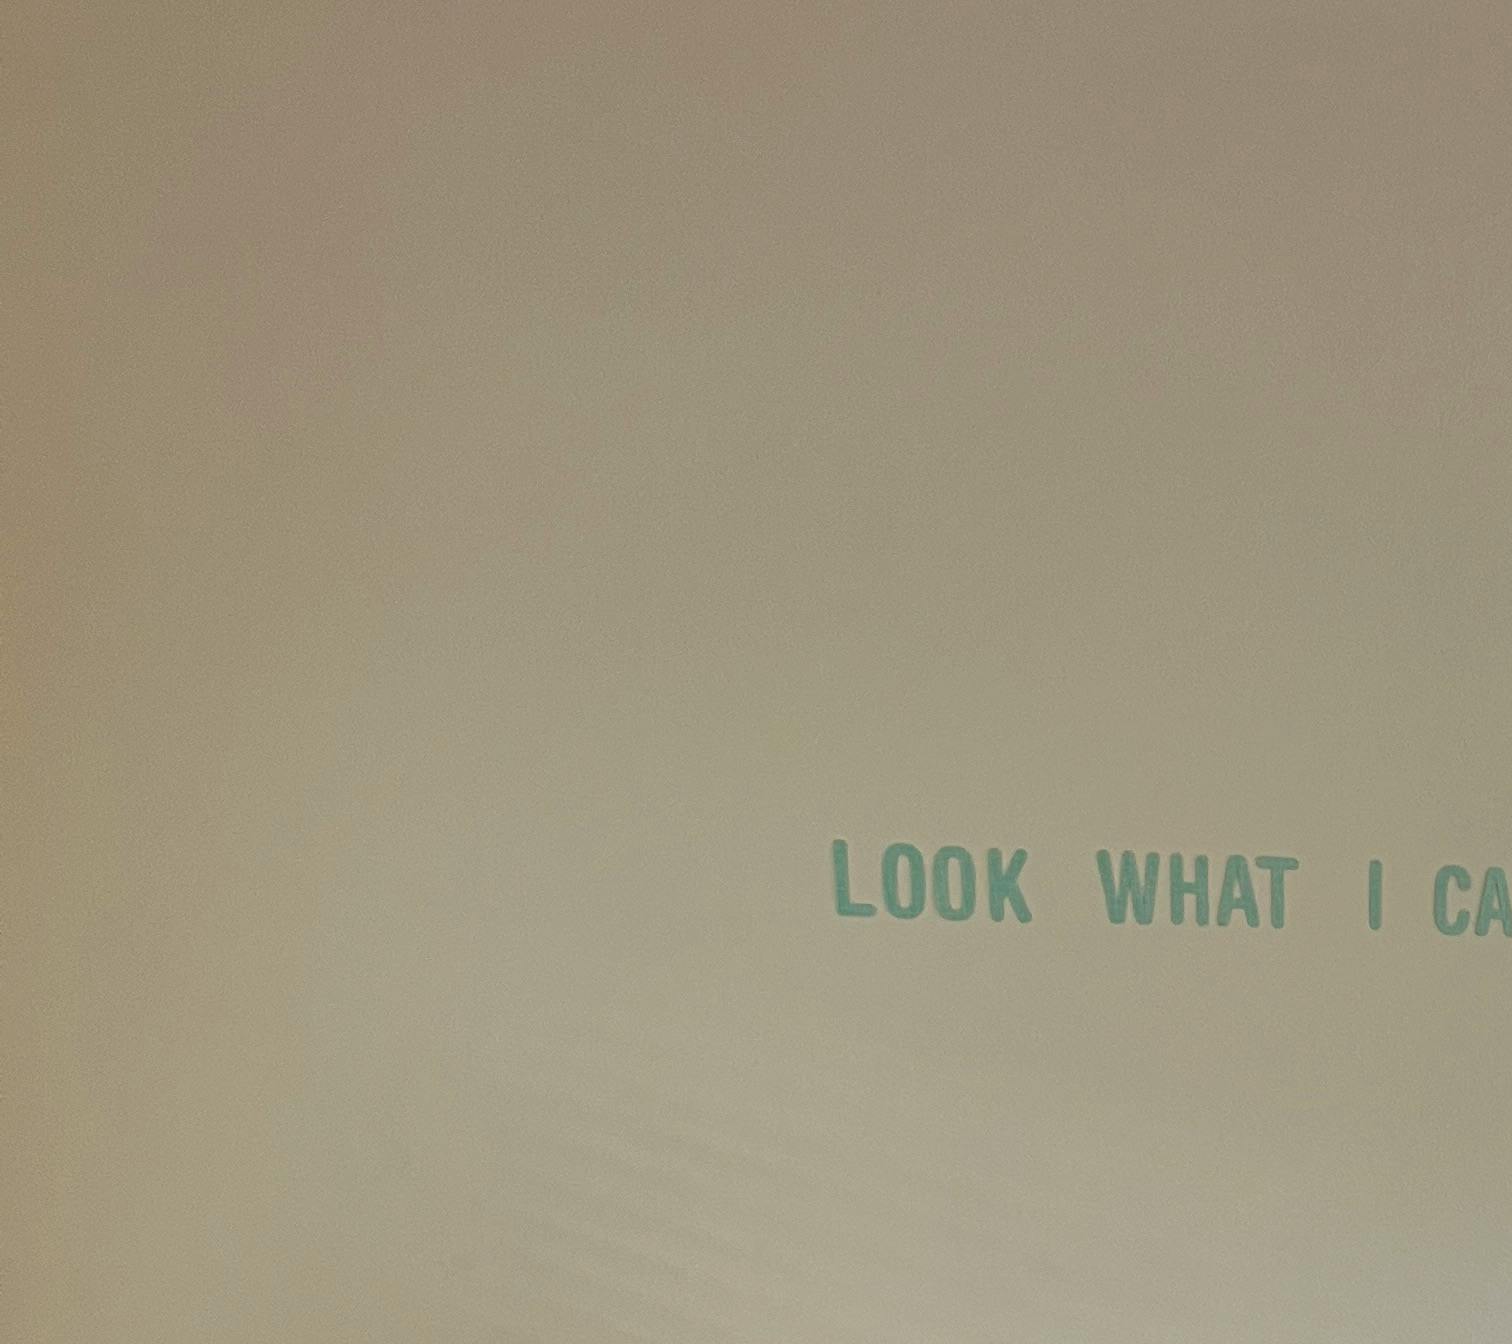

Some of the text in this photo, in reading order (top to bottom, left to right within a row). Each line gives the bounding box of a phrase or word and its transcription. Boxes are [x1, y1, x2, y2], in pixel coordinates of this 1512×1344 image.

[833, 839, 1032, 922] LOOK
[1097, 849, 1299, 928] WHAT
[1369, 859, 1382, 930] I
